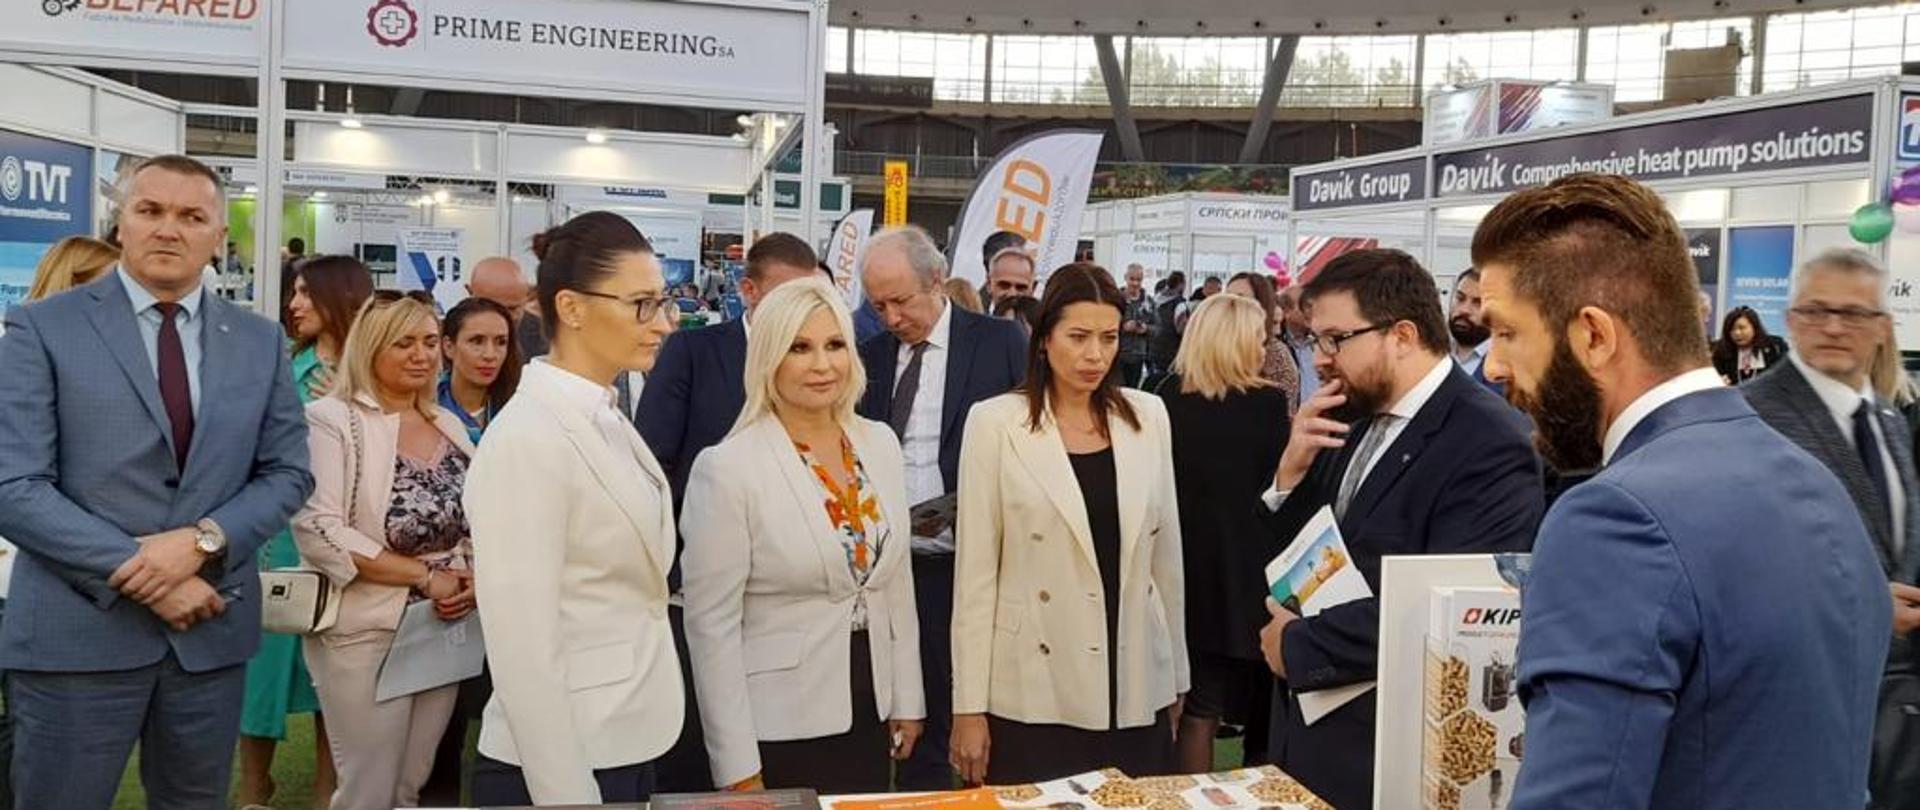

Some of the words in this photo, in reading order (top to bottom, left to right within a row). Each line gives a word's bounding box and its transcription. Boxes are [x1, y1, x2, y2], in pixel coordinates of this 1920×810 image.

[433, 15, 521, 42] PRIME
[532, 23, 717, 57] ENGINEERING
[718, 46, 735, 59] SA
[1441, 153, 1507, 192] Davik
[1512, 151, 1635, 187] Comprehensive
[1638, 145, 1681, 174] heat
[1685, 144, 1747, 179] pump
[1750, 127, 1864, 163] solutions
[23, 160, 72, 204] TVT
[1309, 171, 1354, 203] Davik
[1360, 173, 1411, 200] Group
[996, 158, 1052, 258] ED
[1198, 206, 1251, 219] СРПСКИ
